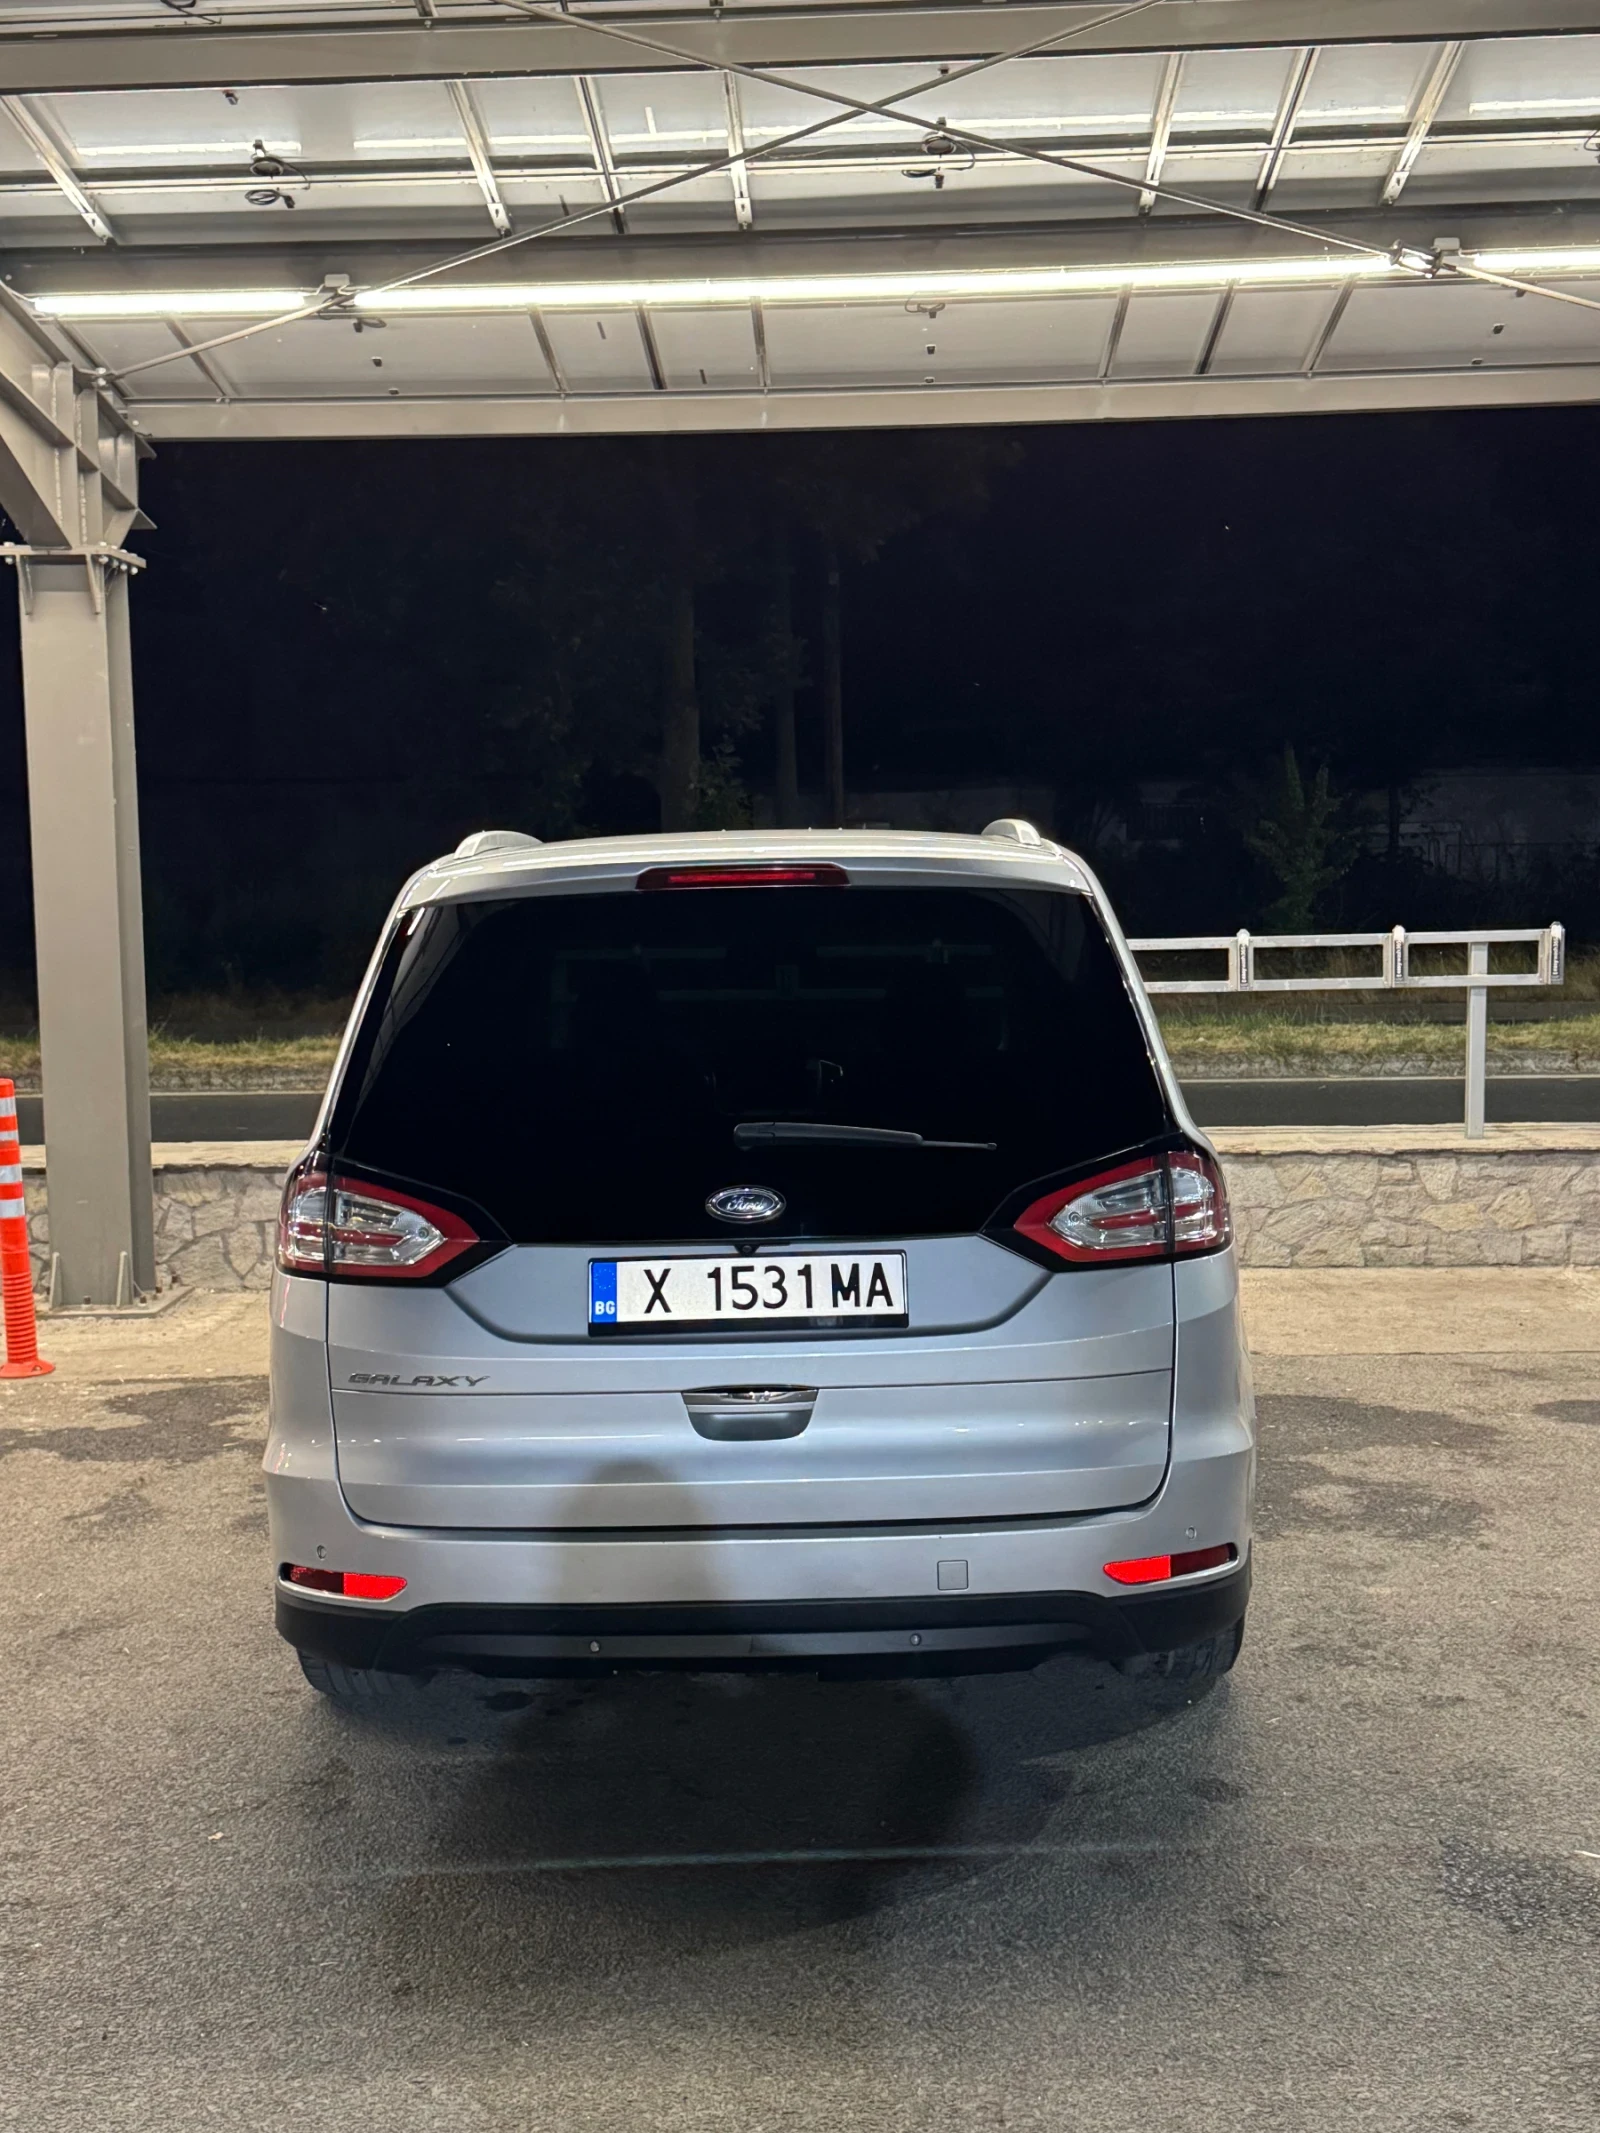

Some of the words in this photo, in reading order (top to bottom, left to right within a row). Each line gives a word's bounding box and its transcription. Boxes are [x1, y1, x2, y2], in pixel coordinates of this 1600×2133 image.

[726, 1194, 767, 1210] Ford
[643, 1268, 672, 1314] X
[707, 1264, 813, 1312] 1531
[831, 1262, 893, 1308] MA
[594, 1300, 616, 1315] BG
[348, 1373, 490, 1387] GALAXY
